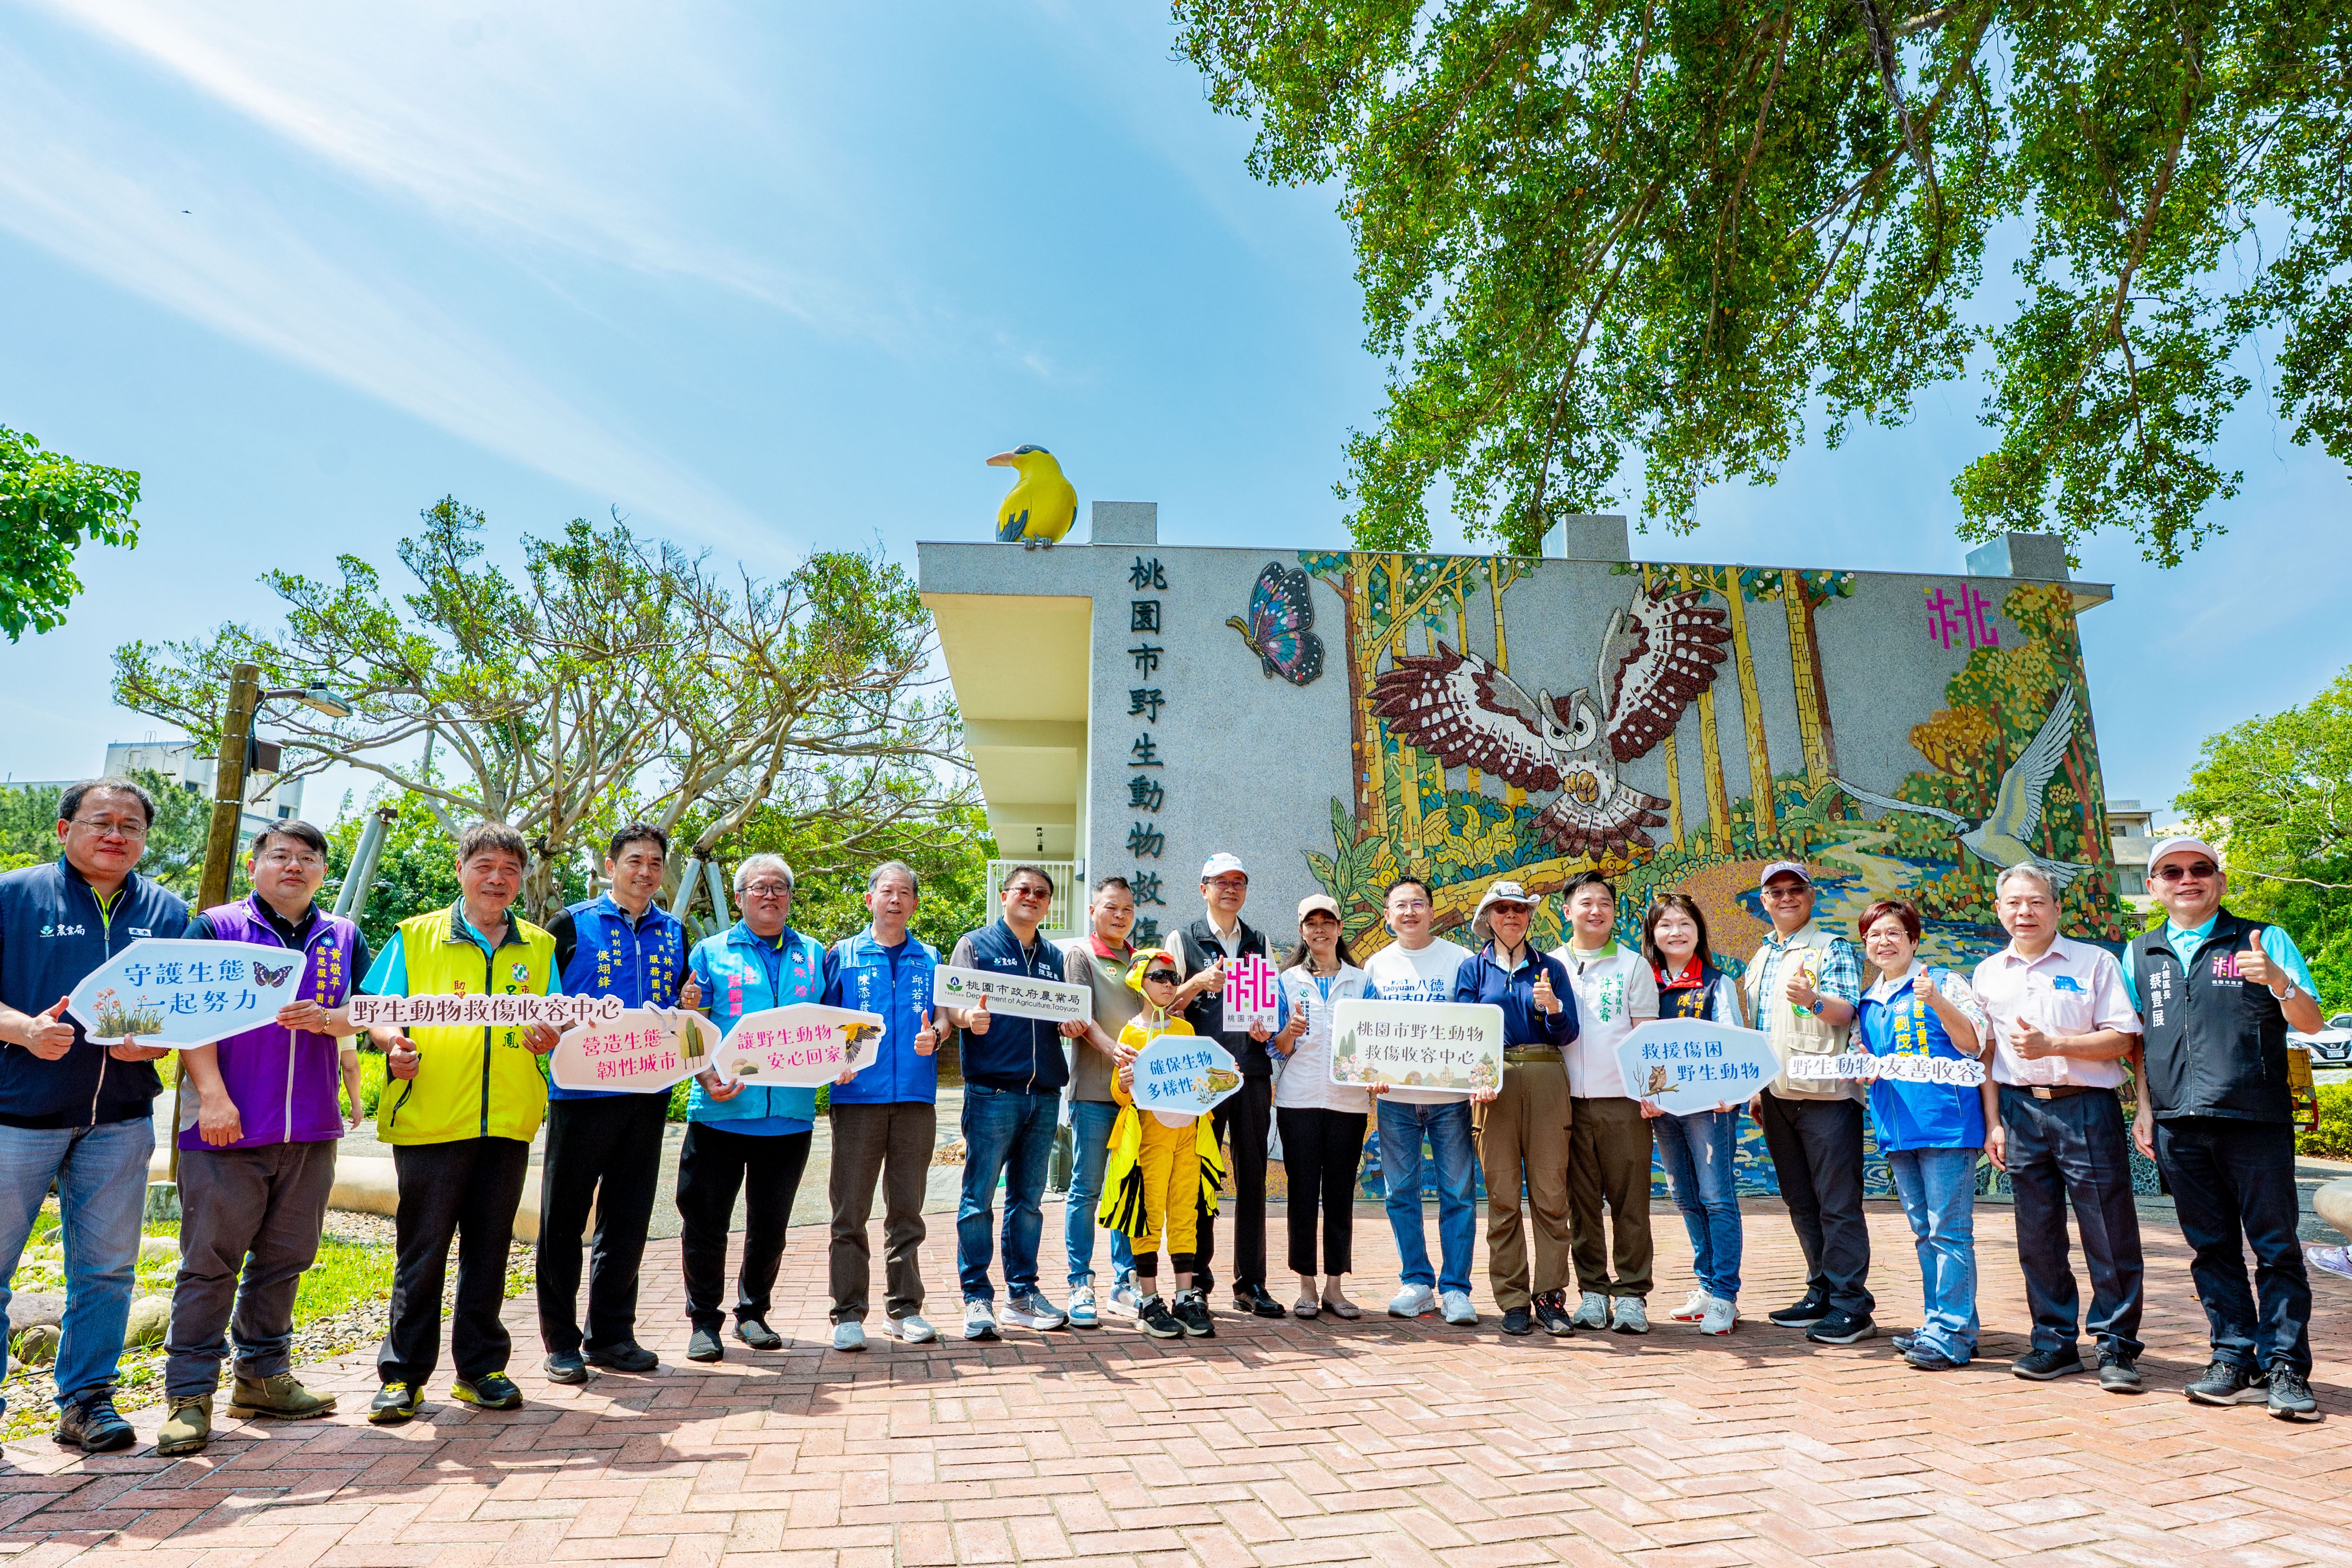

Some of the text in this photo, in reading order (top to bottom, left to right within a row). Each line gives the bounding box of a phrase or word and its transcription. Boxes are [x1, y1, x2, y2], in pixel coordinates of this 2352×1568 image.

[57, 924, 86, 937] 農業局
[611, 929, 623, 966] 特別助理
[123, 959, 245, 987] 守護生態
[329, 948, 342, 991] 黃敬平
[596, 950, 612, 989] 侯翊鋒
[649, 955, 662, 1002] 服務團隊
[2162, 961, 2171, 999] 八德區長
[911, 975, 924, 1015] 邱若華
[966, 980, 1080, 1005] 桃園市政府農業局
[966, 991, 1007, 1003] Deptment
[1415, 979, 1444, 992] 八德
[1615, 972, 1624, 1016] 桃園市議員
[138, 989, 256, 1015] 一起努力
[353, 999, 620, 1022] 野生動物救傷收容中心
[1599, 977, 1613, 1022] 許家睿
[1694, 992, 1704, 1019] 市議員
[1228, 1014, 1274, 1023] 桃園市政府
[1356, 1021, 1483, 1042] 桃園市野生動物
[583, 1029, 661, 1056] 營造生態
[737, 1024, 832, 1050] 讓野生動物
[1641, 1041, 1722, 1059] 救援傷困
[596, 1051, 677, 1080] 韌性城市
[767, 1045, 843, 1070] 安心回家
[1149, 1051, 1212, 1075] 確保生物
[1365, 1044, 1474, 1064] 救傷收容中心
[1677, 1062, 1759, 1082] 野生動物
[1147, 1077, 1196, 1101] 多樣性
